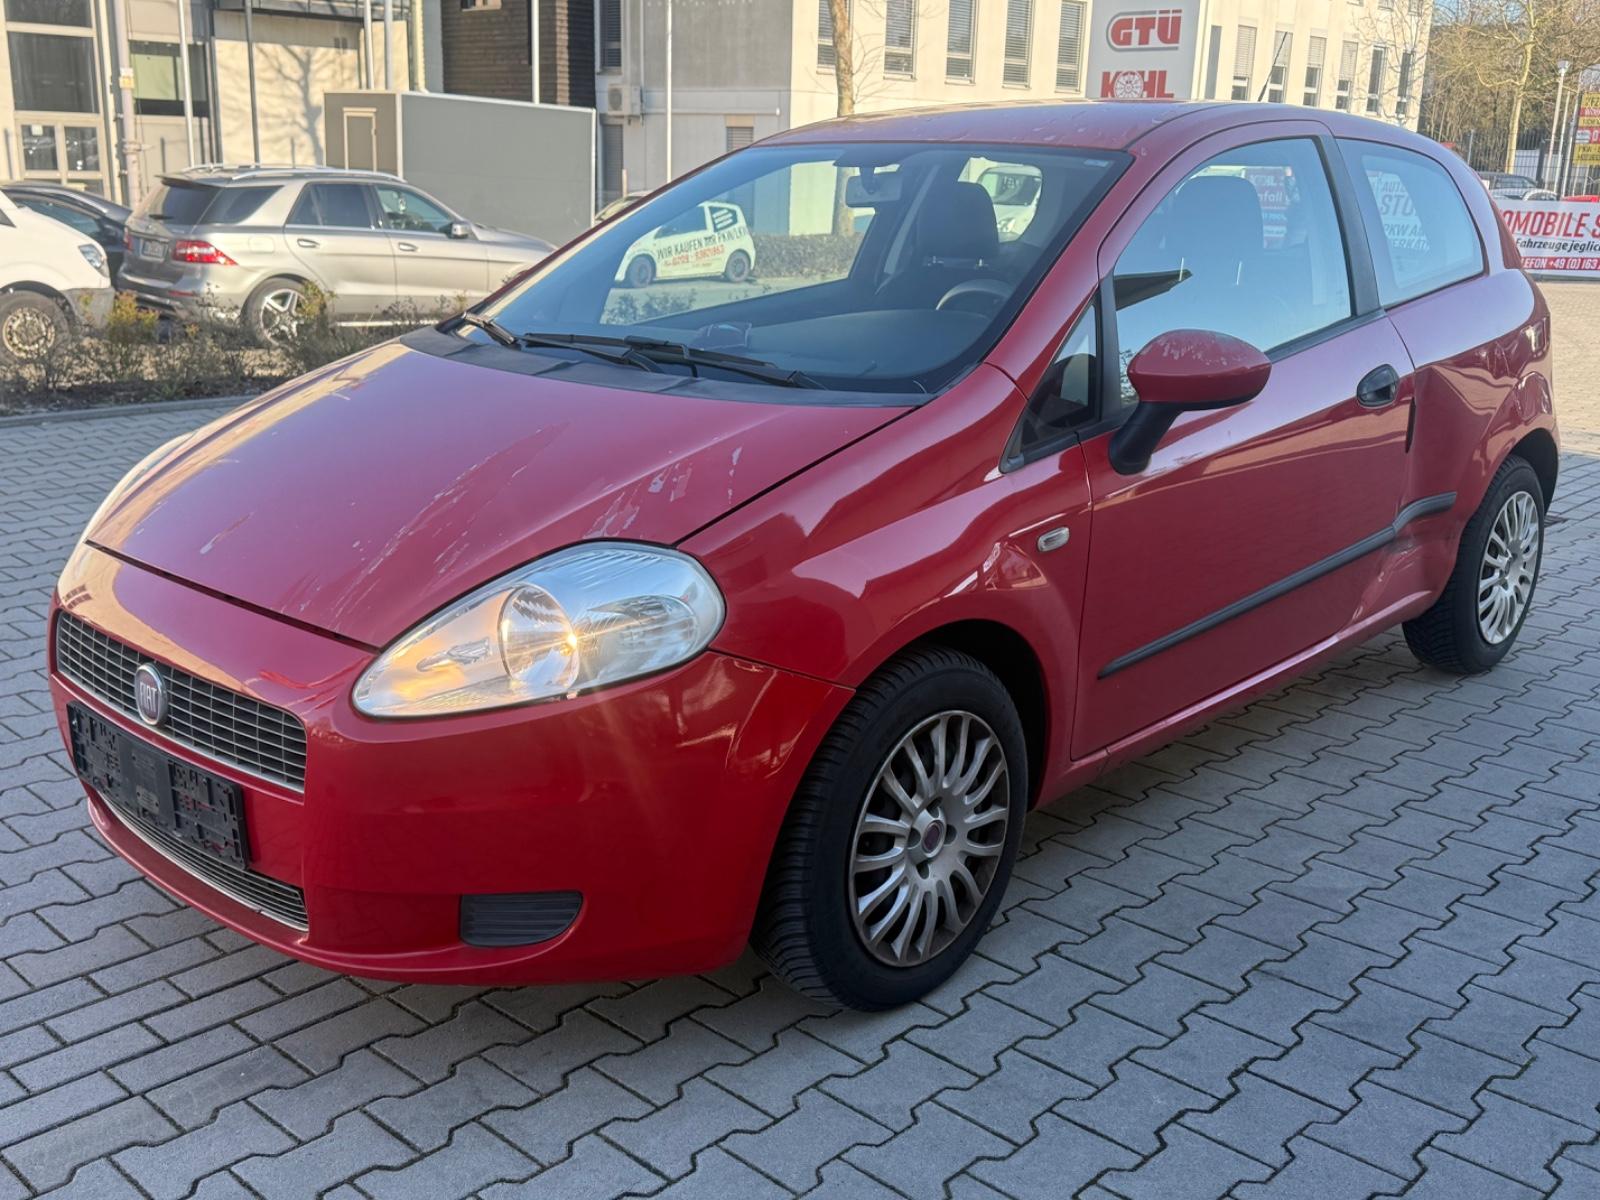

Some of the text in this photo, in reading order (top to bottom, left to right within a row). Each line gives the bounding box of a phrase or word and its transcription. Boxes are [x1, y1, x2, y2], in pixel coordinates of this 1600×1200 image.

[1110, 9, 1182, 46] GTÜ
[1100, 69, 1175, 99] KOHL
[1500, 210, 1590, 237] OMOBILE
[674, 238, 703, 255] KAUFEN
[1516, 239, 1568, 252] Fahrzeuge
[140, 681, 157, 712] FIAT
